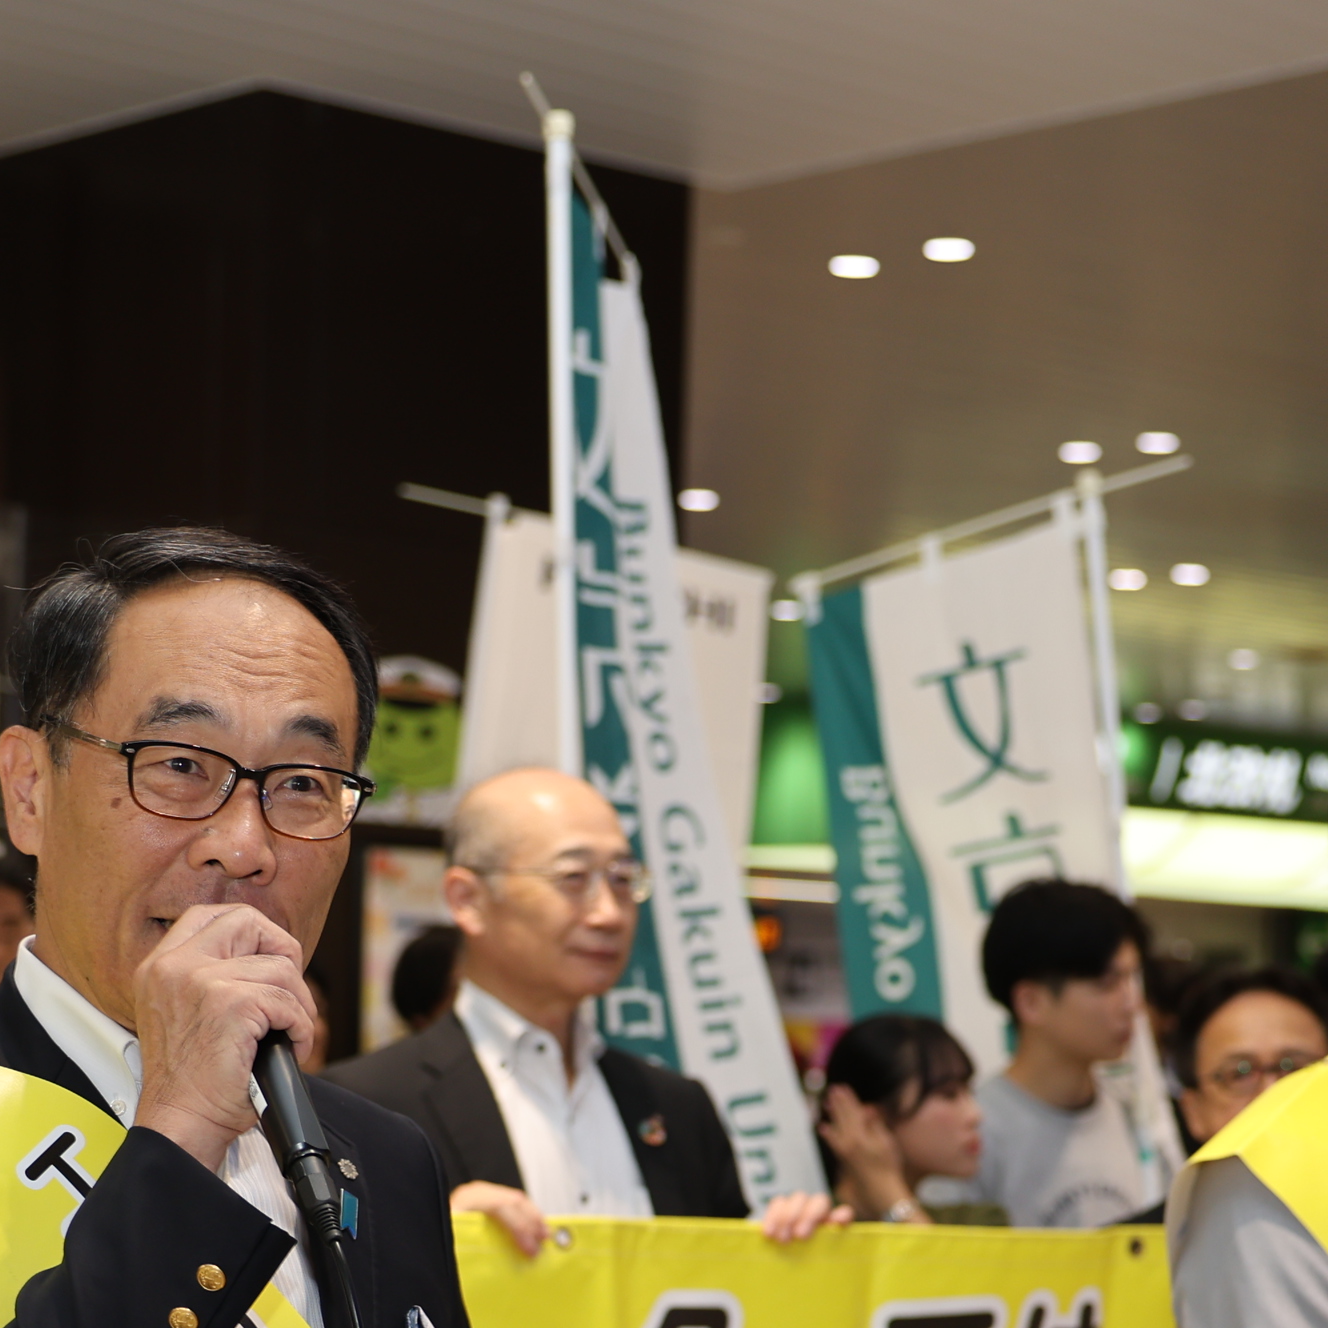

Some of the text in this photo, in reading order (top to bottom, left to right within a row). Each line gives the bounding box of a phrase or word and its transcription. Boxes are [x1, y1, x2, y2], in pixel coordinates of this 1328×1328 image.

[658, 803, 742, 1062] Gakuin
[728, 1092, 776, 1205] Un
[839, 764, 926, 1003] Bunkyo
